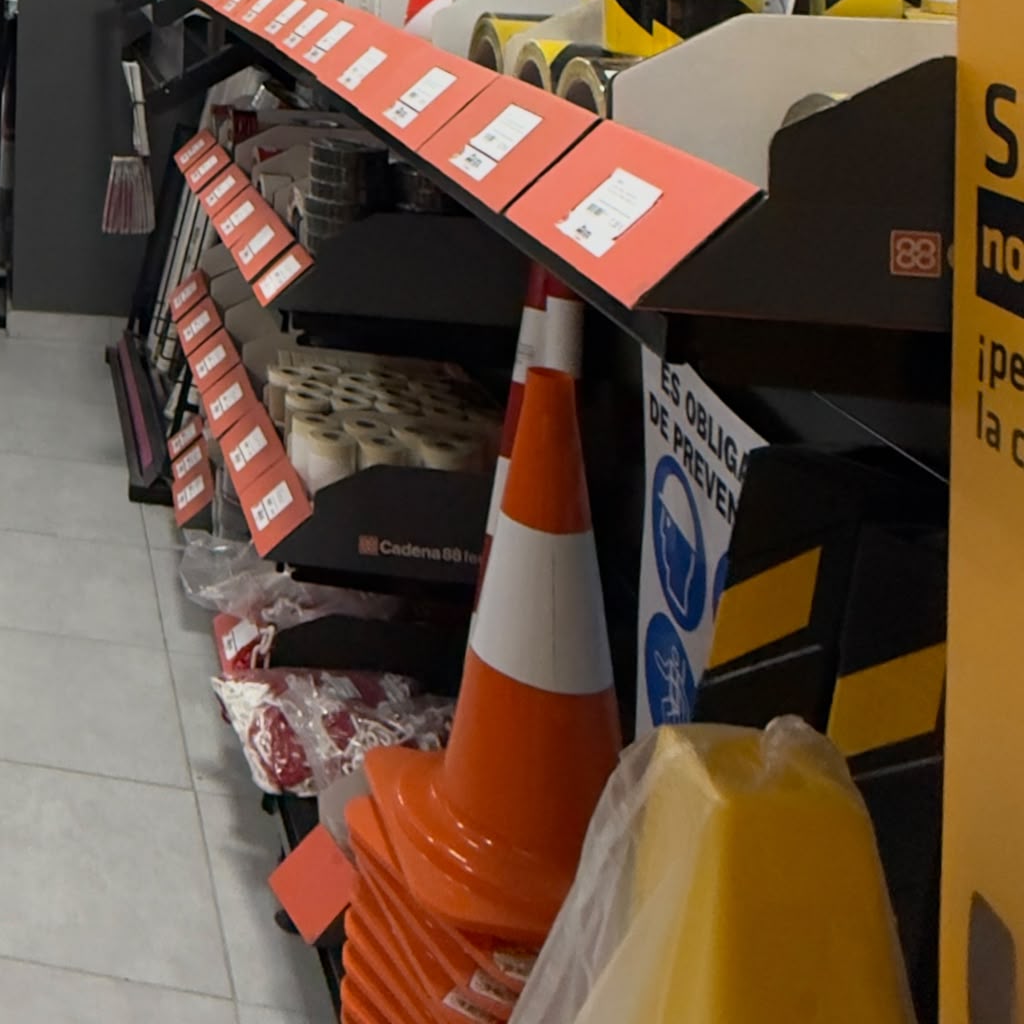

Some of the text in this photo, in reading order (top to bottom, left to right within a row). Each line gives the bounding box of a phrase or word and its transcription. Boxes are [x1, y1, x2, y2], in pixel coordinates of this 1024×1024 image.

[982, 224, 1024, 283] no
[661, 362, 681, 407] ES
[649, 391, 670, 443] DE
[977, 390, 1001, 453] la
[379, 539, 441, 560] Cadena
[442, 547, 462, 564] 88
